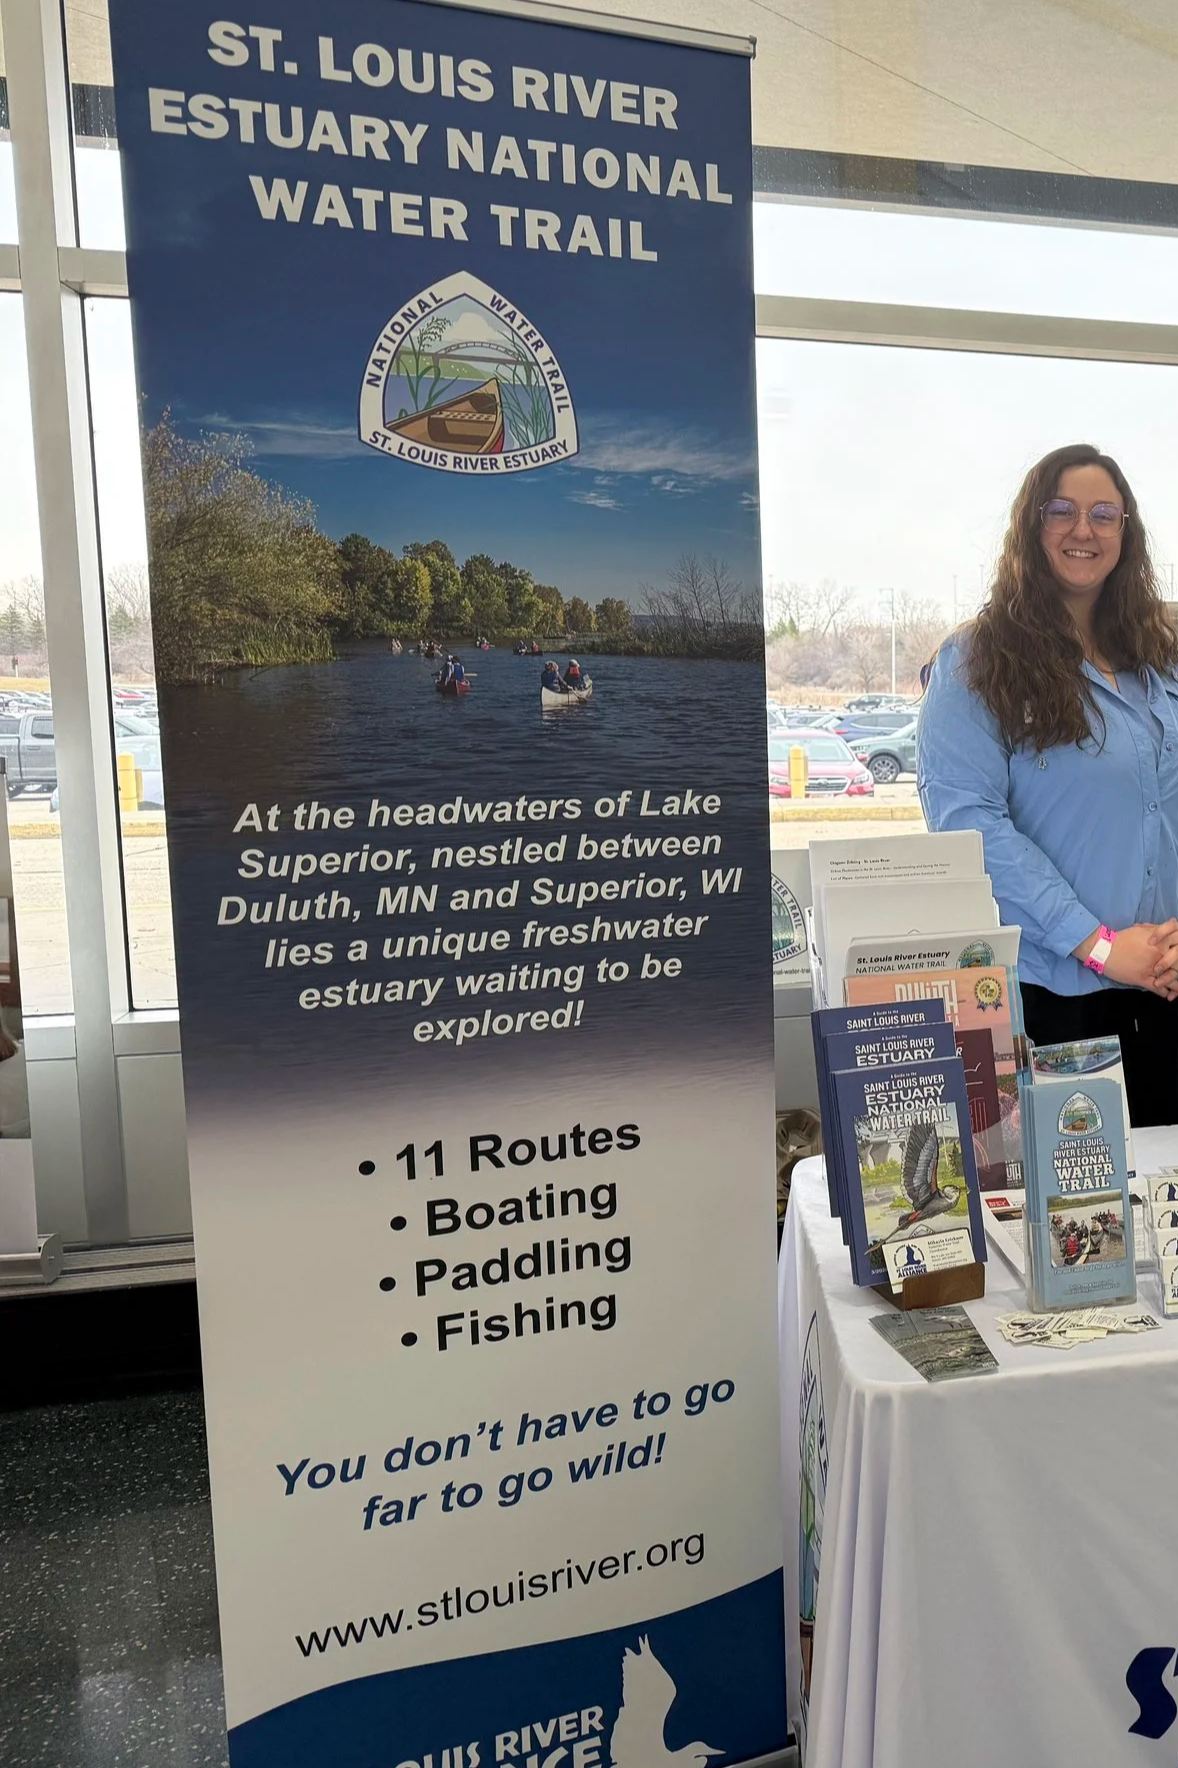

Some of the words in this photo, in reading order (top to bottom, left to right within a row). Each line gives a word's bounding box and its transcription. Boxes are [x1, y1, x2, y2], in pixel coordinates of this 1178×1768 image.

[206, 19, 299, 76] ST.
[318, 35, 494, 102] LOUIS
[511, 64, 679, 131] RIVER
[148, 87, 430, 165] ESTUARY
[445, 127, 734, 205] NATIONAL
[248, 174, 470, 242] WATER
[490, 203, 658, 263] TRAIL
[366, 291, 443, 388] NATIONAL
[489, 294, 544, 352] WATER
[542, 356, 570, 414] TRAIL
[369, 430, 393, 451] ST.
[397, 442, 448, 467] LOUIS
[452, 456, 499, 471] RIVER
[503, 439, 569, 469] ESTUARY
[233, 801, 282, 834] At
[292, 799, 357, 832] the
[367, 793, 583, 829] headwaters
[593, 790, 632, 818] of
[639, 788, 723, 817] Lake
[237, 846, 418, 884] Superior,
[430, 835, 567, 872] nestled
[576, 831, 724, 862] between
[217, 889, 361, 927] Duluth,
[375, 885, 439, 917] MN
[448, 880, 519, 912] and
[530, 871, 688, 908] Superior,
[700, 866, 744, 895] WI
[771, 877, 788, 898] TER
[787, 898, 802, 930] TRAIL
[264, 938, 335, 970] lies
[346, 939, 369, 964] a
[381, 926, 513, 962] unique
[522, 913, 710, 948] freshwater
[773, 943, 802, 961] TUARY
[857, 956, 868, 964] St.
[870, 954, 893, 964] Louis
[894, 952, 917, 962] River
[918, 950, 951, 961] Estuary
[297, 971, 445, 1012] estuary
[454, 961, 586, 997] waiting
[596, 957, 631, 984] to
[640, 953, 684, 980] be
[855, 964, 896, 975] NATIONAL
[897, 962, 925, 972] WATER
[926, 960, 947, 969] TRAIL
[412, 1000, 585, 1046] explored!
[846, 1017, 873, 1030] SAINT
[874, 1014, 899, 1027] LOUIS
[900, 1012, 926, 1024] RIVER
[854, 1042, 881, 1055] SAINT
[882, 1040, 908, 1052] LOUIS
[909, 1037, 935, 1049] RIVER
[856, 1047, 936, 1067] ESTUARY
[863, 1081, 890, 1094] SAINT
[892, 1077, 918, 1090] LOUIS
[919, 1074, 945, 1086] RIVER
[865, 1084, 946, 1106] ESTUARY
[867, 1096, 947, 1117] NATIONAL
[869, 1110, 913, 1132] WATER
[915, 1107, 951, 1126] TRAIL
[396, 1140, 446, 1182] 11
[469, 1120, 642, 1173] Routes
[1053, 1153, 1112, 1169] NATIONAL
[1054, 1149, 1076, 1158] RIVER
[1077, 1145, 1110, 1156] ESTUARY
[1060, 1139, 1081, 1150] SAINT
[1082, 1137, 1104, 1147] LOUIS
[1055, 1163, 1115, 1181] WATER
[1059, 1176, 1110, 1192] TRAIL
[426, 1181, 619, 1238] Boating
[415, 1234, 633, 1297] Paddling
[436, 1292, 618, 1352] Fishing
[275, 1453, 367, 1496] You
[516, 1401, 619, 1446] have
[632, 1389, 673, 1420] to
[684, 1378, 736, 1417] go
[361, 1494, 427, 1531] far
[440, 1480, 484, 1514] to
[497, 1465, 553, 1507] go
[568, 1432, 667, 1483] wild!
[295, 1531, 707, 1658] www.stlouisriver.org
[395, 1741, 480, 1768] UIS
[495, 1705, 605, 1762] RIVER
